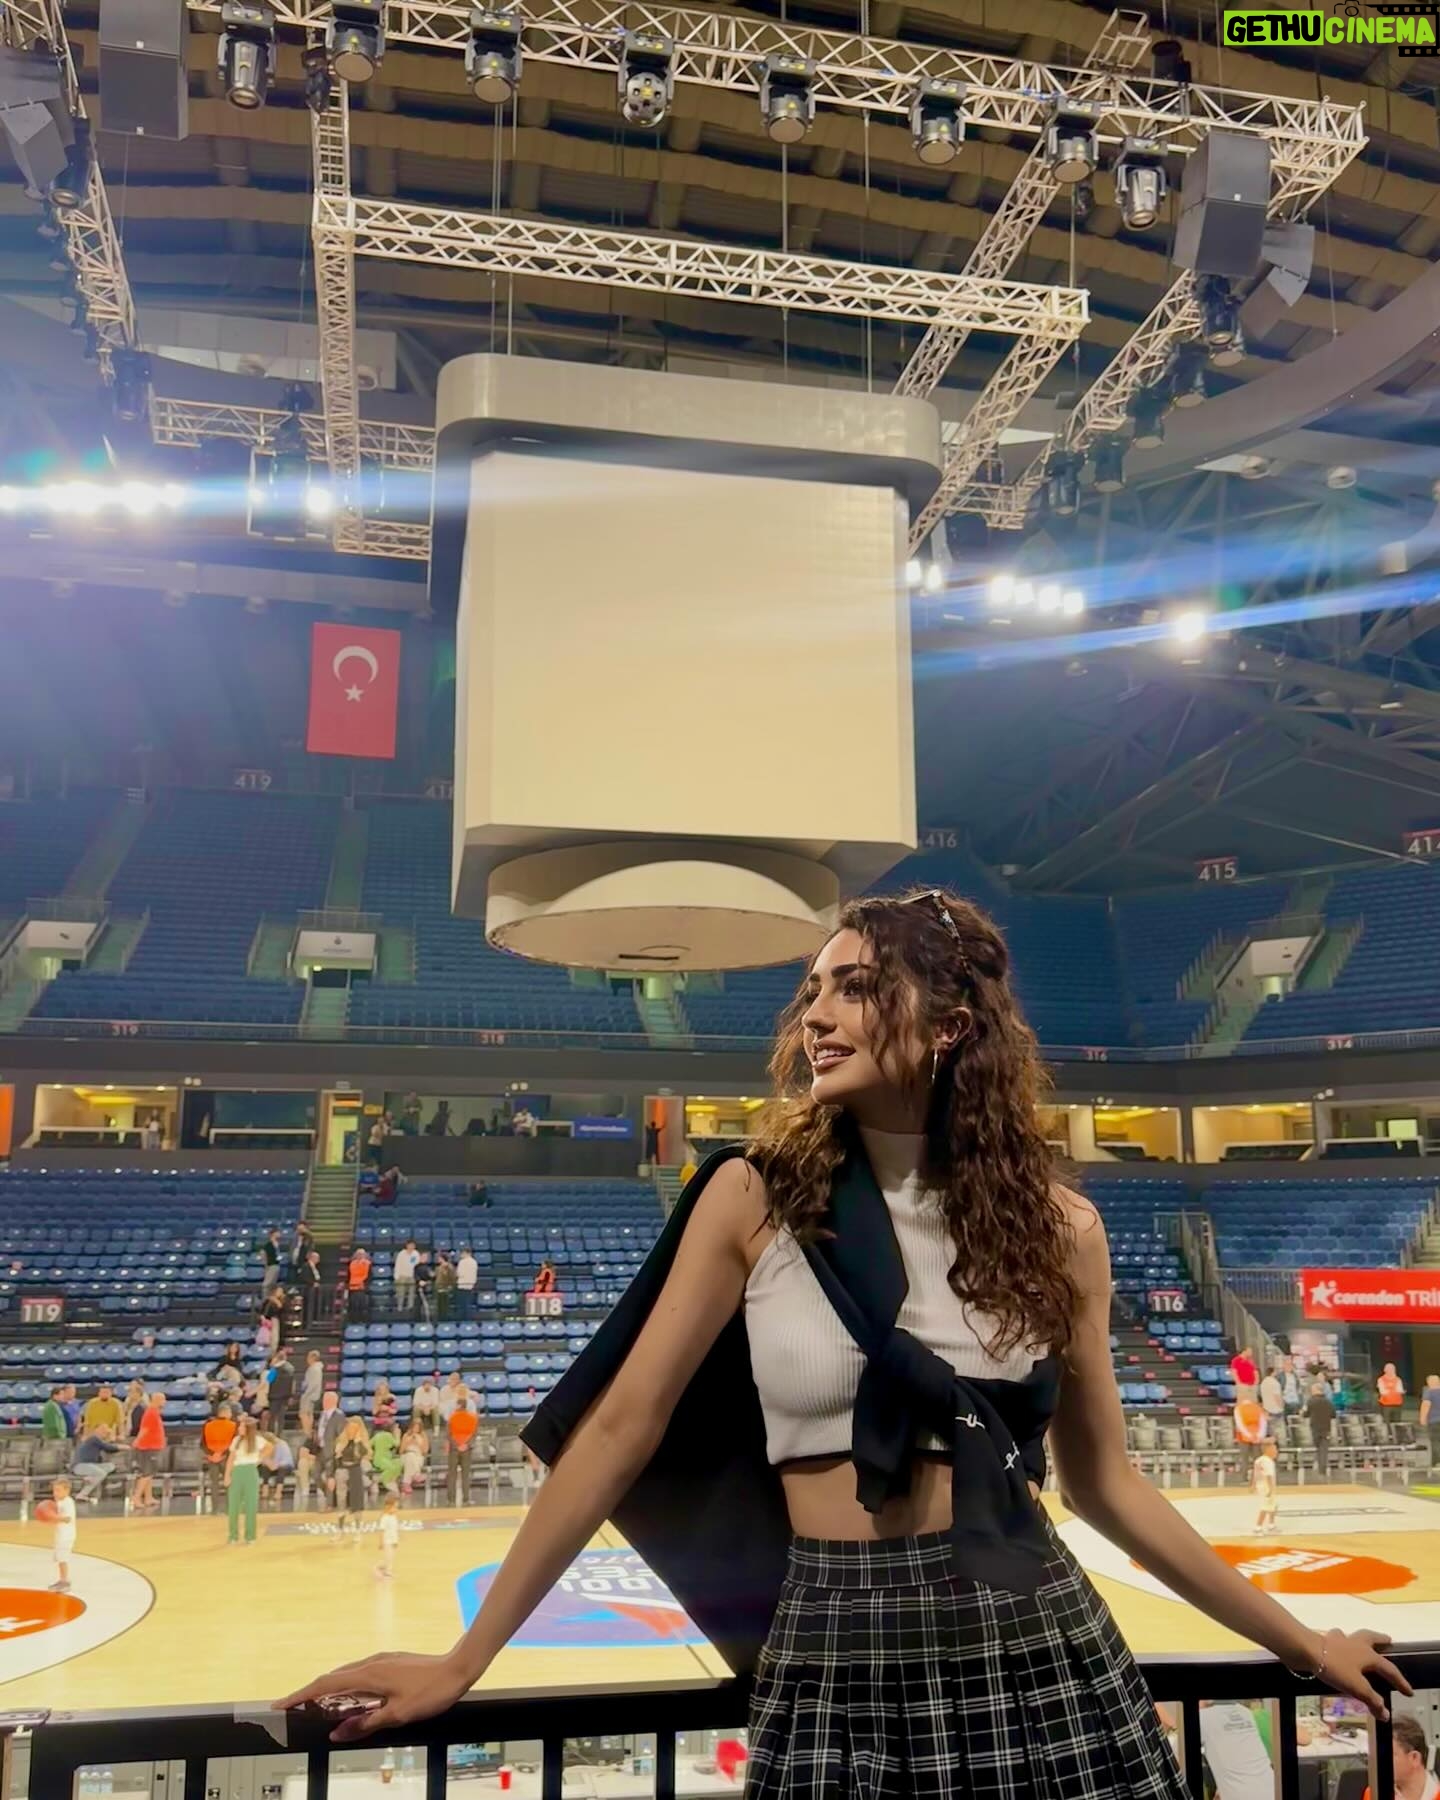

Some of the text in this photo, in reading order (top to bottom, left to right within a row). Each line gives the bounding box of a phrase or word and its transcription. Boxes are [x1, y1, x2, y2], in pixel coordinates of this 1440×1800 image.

[234, 774, 272, 791] 419
[926, 832, 957, 848] 416
[1408, 836, 1440, 854] 41
[1199, 862, 1236, 880] 415
[528, 1298, 562, 1315] 118
[1152, 1295, 1184, 1311] 116
[23, 1304, 61, 1322] 119
